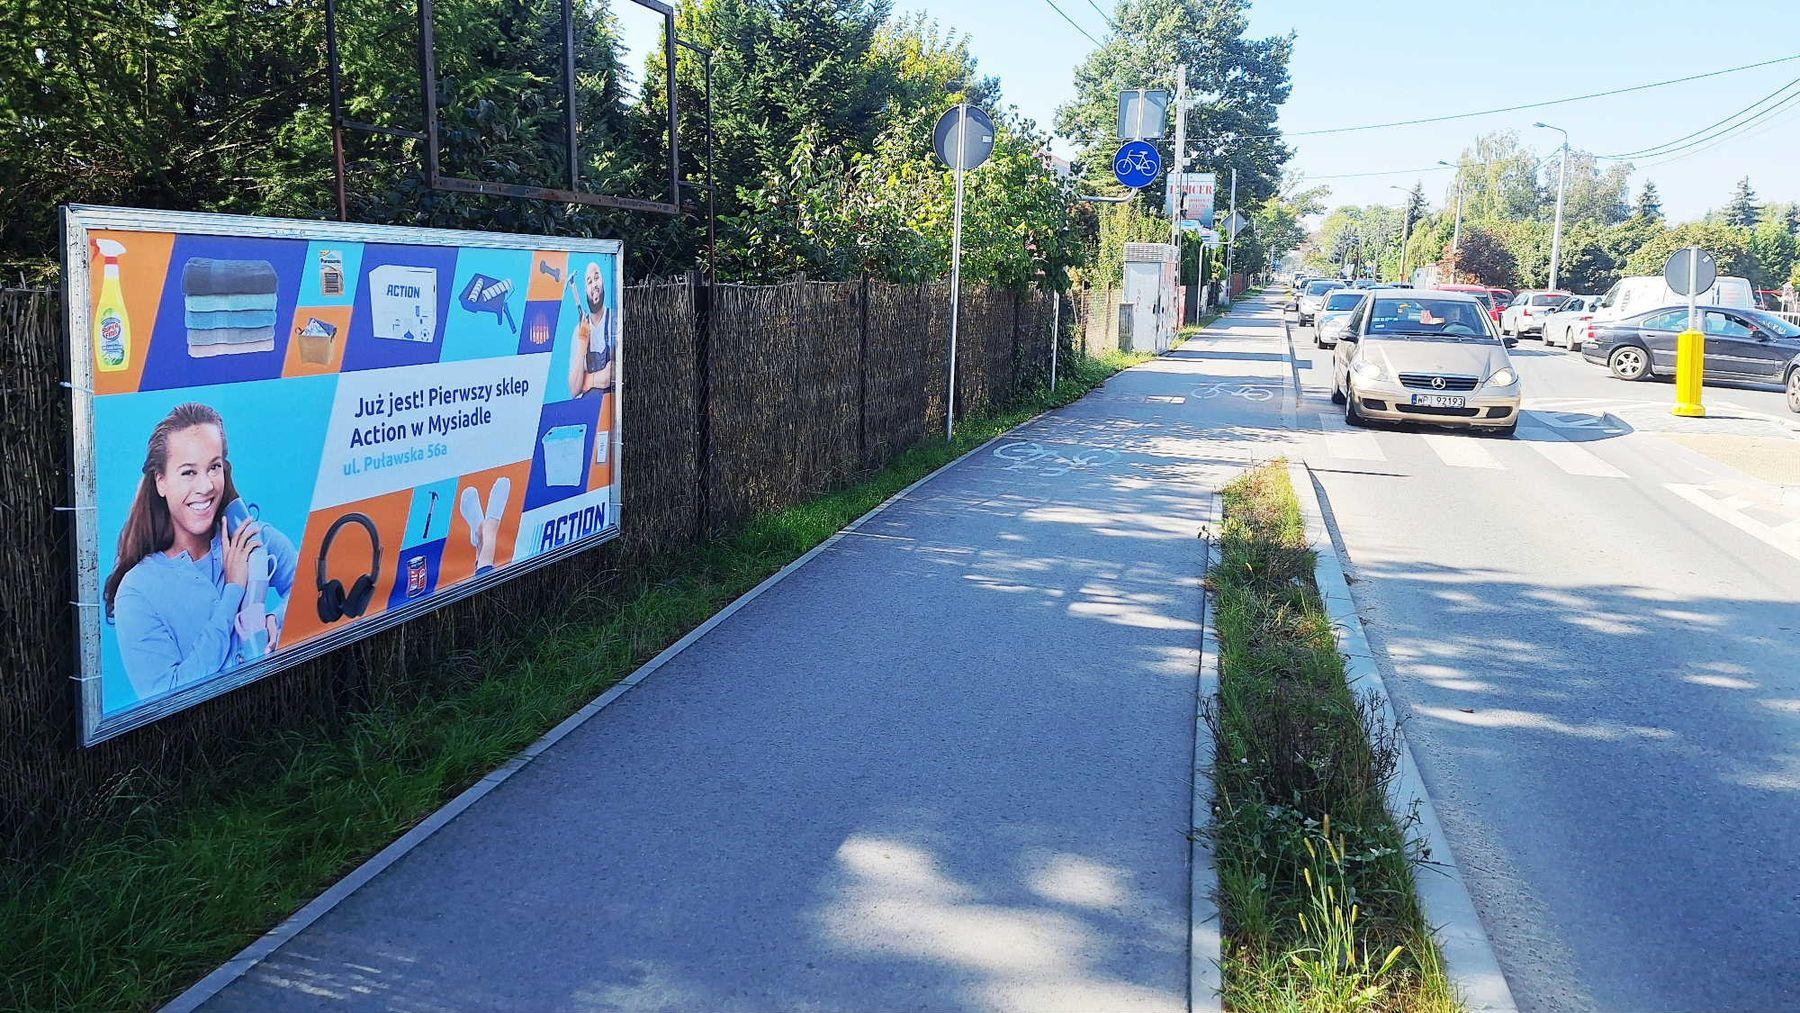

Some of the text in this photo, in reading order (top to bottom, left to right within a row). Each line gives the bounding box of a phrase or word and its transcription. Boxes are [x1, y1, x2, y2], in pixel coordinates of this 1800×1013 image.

[386, 284, 421, 299] ACTION
[354, 376, 530, 418] Już jest! Pierwszy sklep
[349, 406, 492, 449] Action w Mysiadle
[343, 442, 448, 476] ul. Puławska 56a
[540, 502, 606, 553] ACTION
